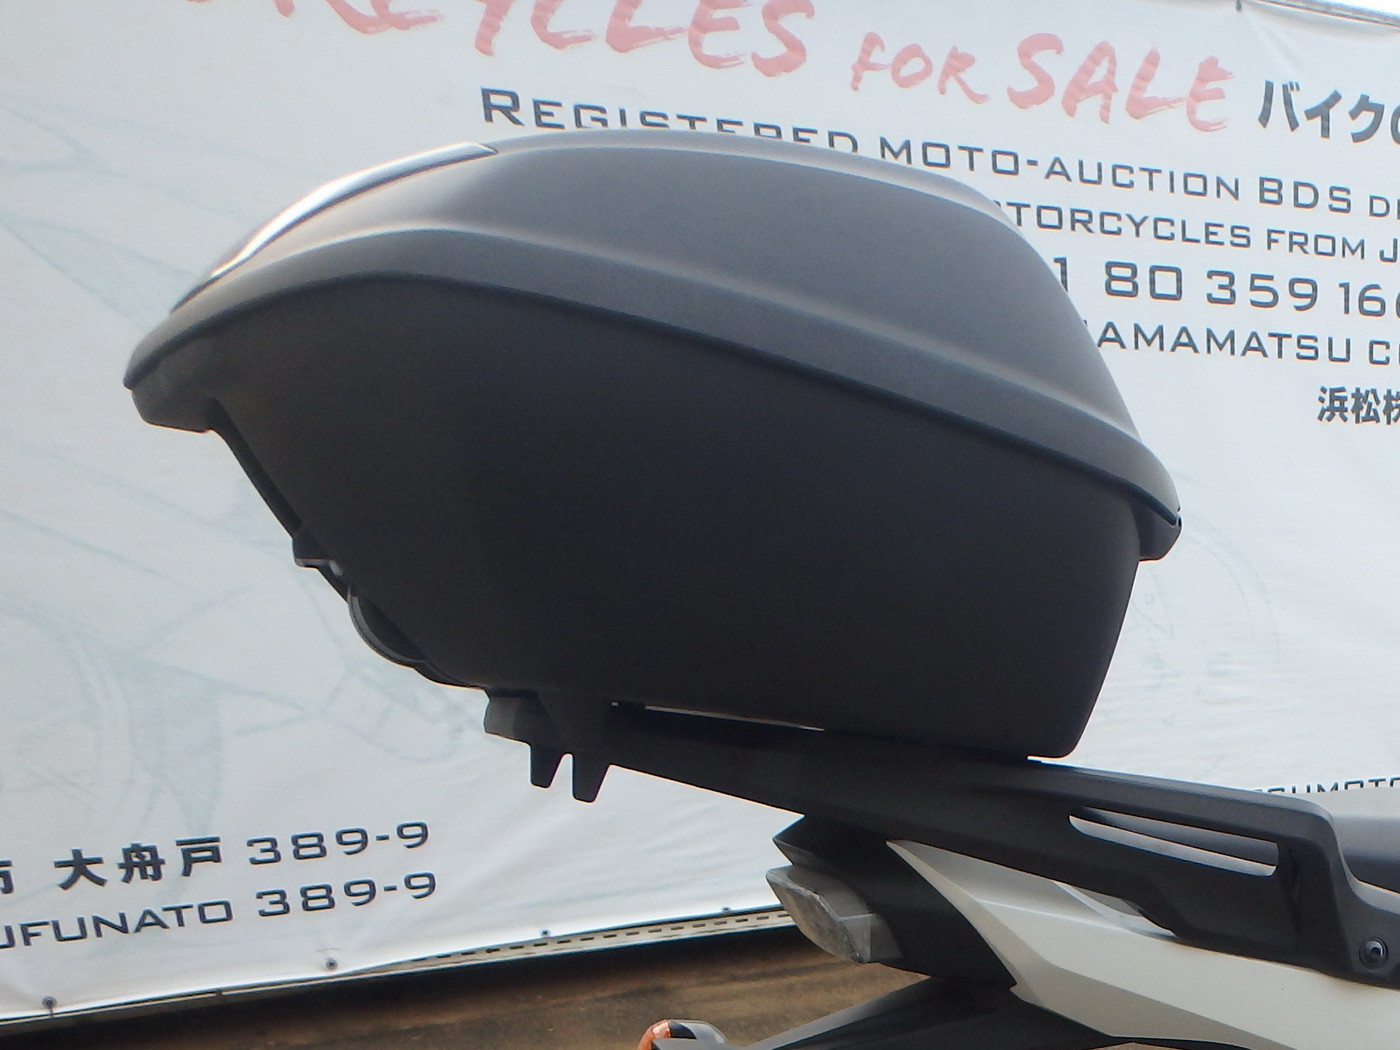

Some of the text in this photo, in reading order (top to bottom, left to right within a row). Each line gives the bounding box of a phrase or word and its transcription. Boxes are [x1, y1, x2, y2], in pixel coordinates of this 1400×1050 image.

[850, 31, 989, 106] FOR
[1006, 32, 1238, 133] SALE
[880, 136, 1241, 203] MOTO-AUCTION
[1257, 176, 1353, 214] BDS
[992, 200, 1252, 249] TORCYCLES
[1266, 228, 1365, 261] FROM
[1103, 259, 1184, 303] 80
[1205, 269, 1319, 313] 359
[1083, 319, 1352, 364] AMAMATSU
[52, 834, 223, 892] 大舟戸
[245, 819, 431, 867] 389-9
[254, 870, 438, 919] 389-9
